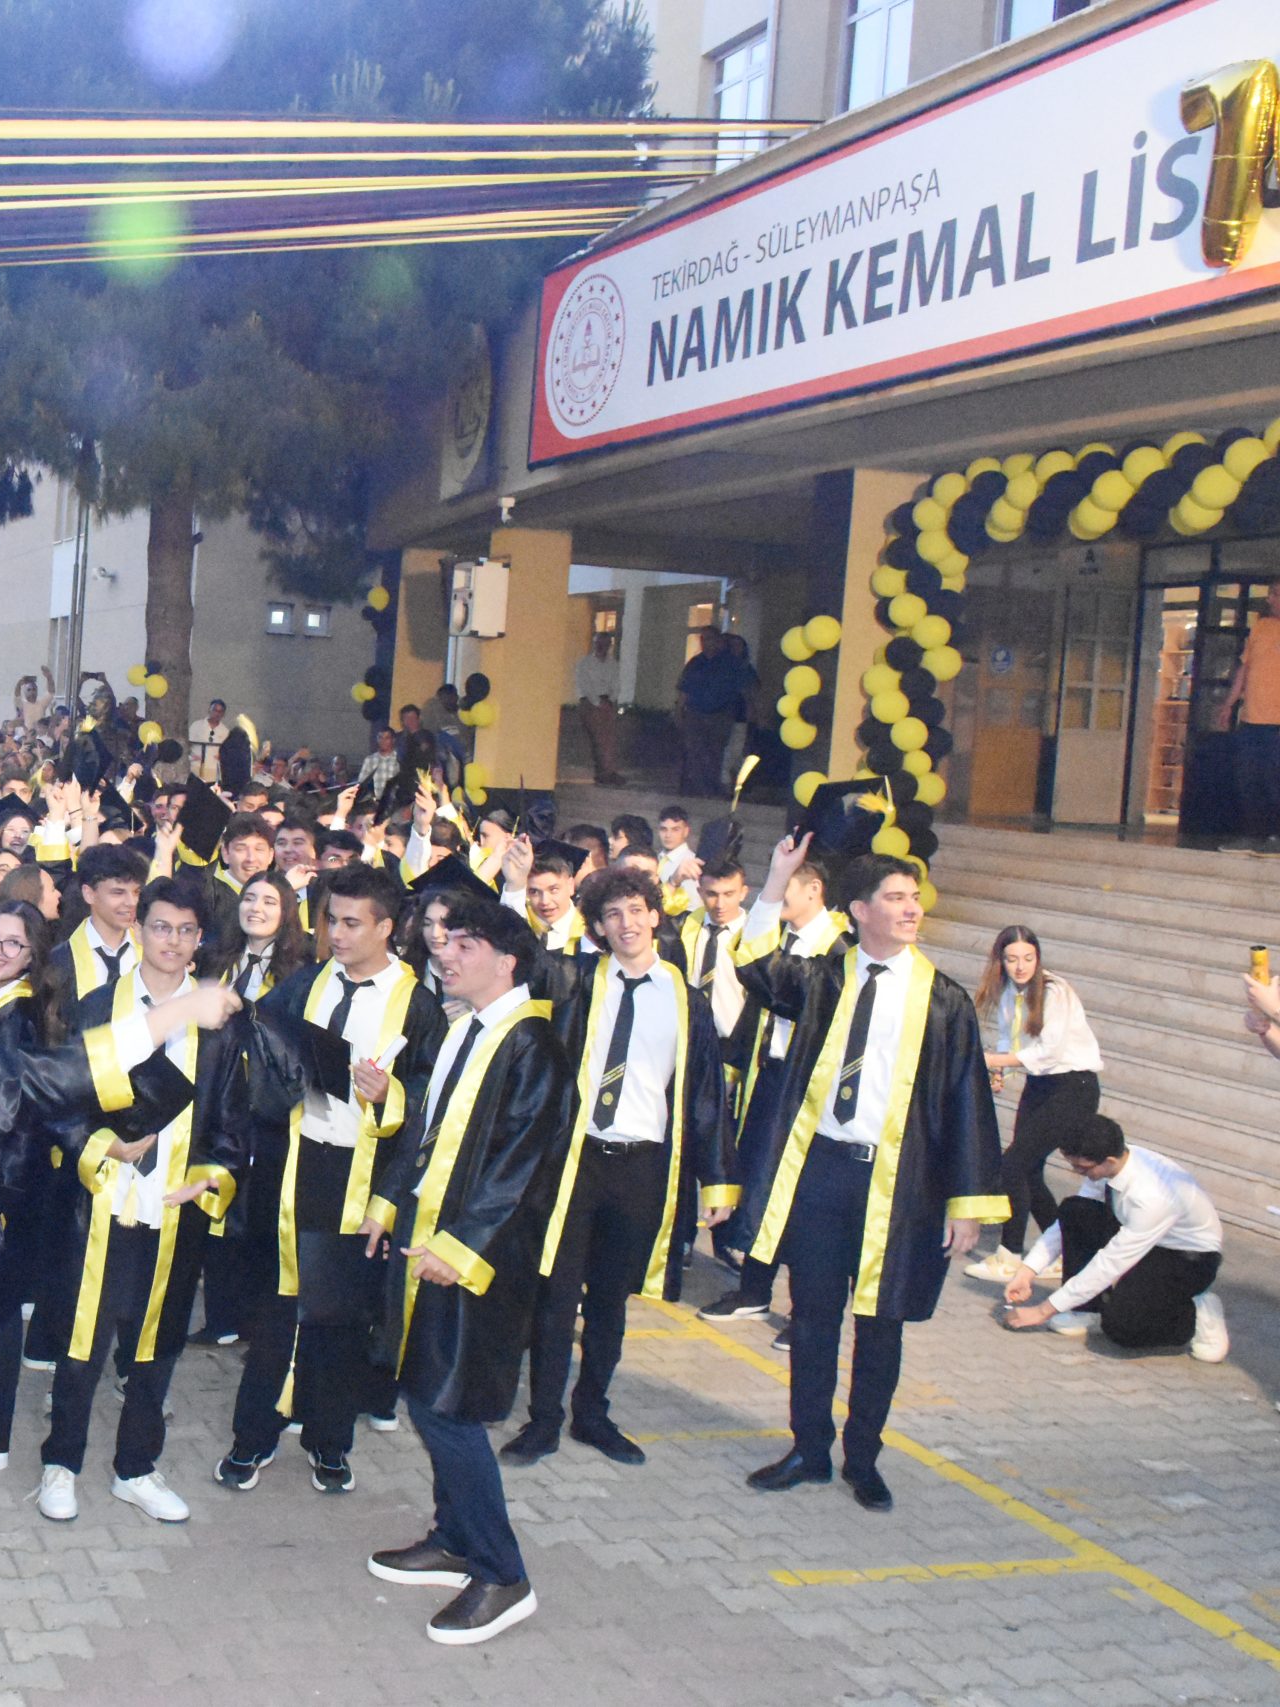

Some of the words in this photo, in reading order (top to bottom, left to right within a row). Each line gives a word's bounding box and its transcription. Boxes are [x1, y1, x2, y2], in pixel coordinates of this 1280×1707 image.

[647, 268, 813, 387] NAMIK
[823, 191, 1051, 336] KEMAL
[1076, 130, 1280, 264] LİS
[651, 240, 739, 301] TEKİRDAĞ
[755, 168, 941, 264] SÜLEYMANPAŞA
